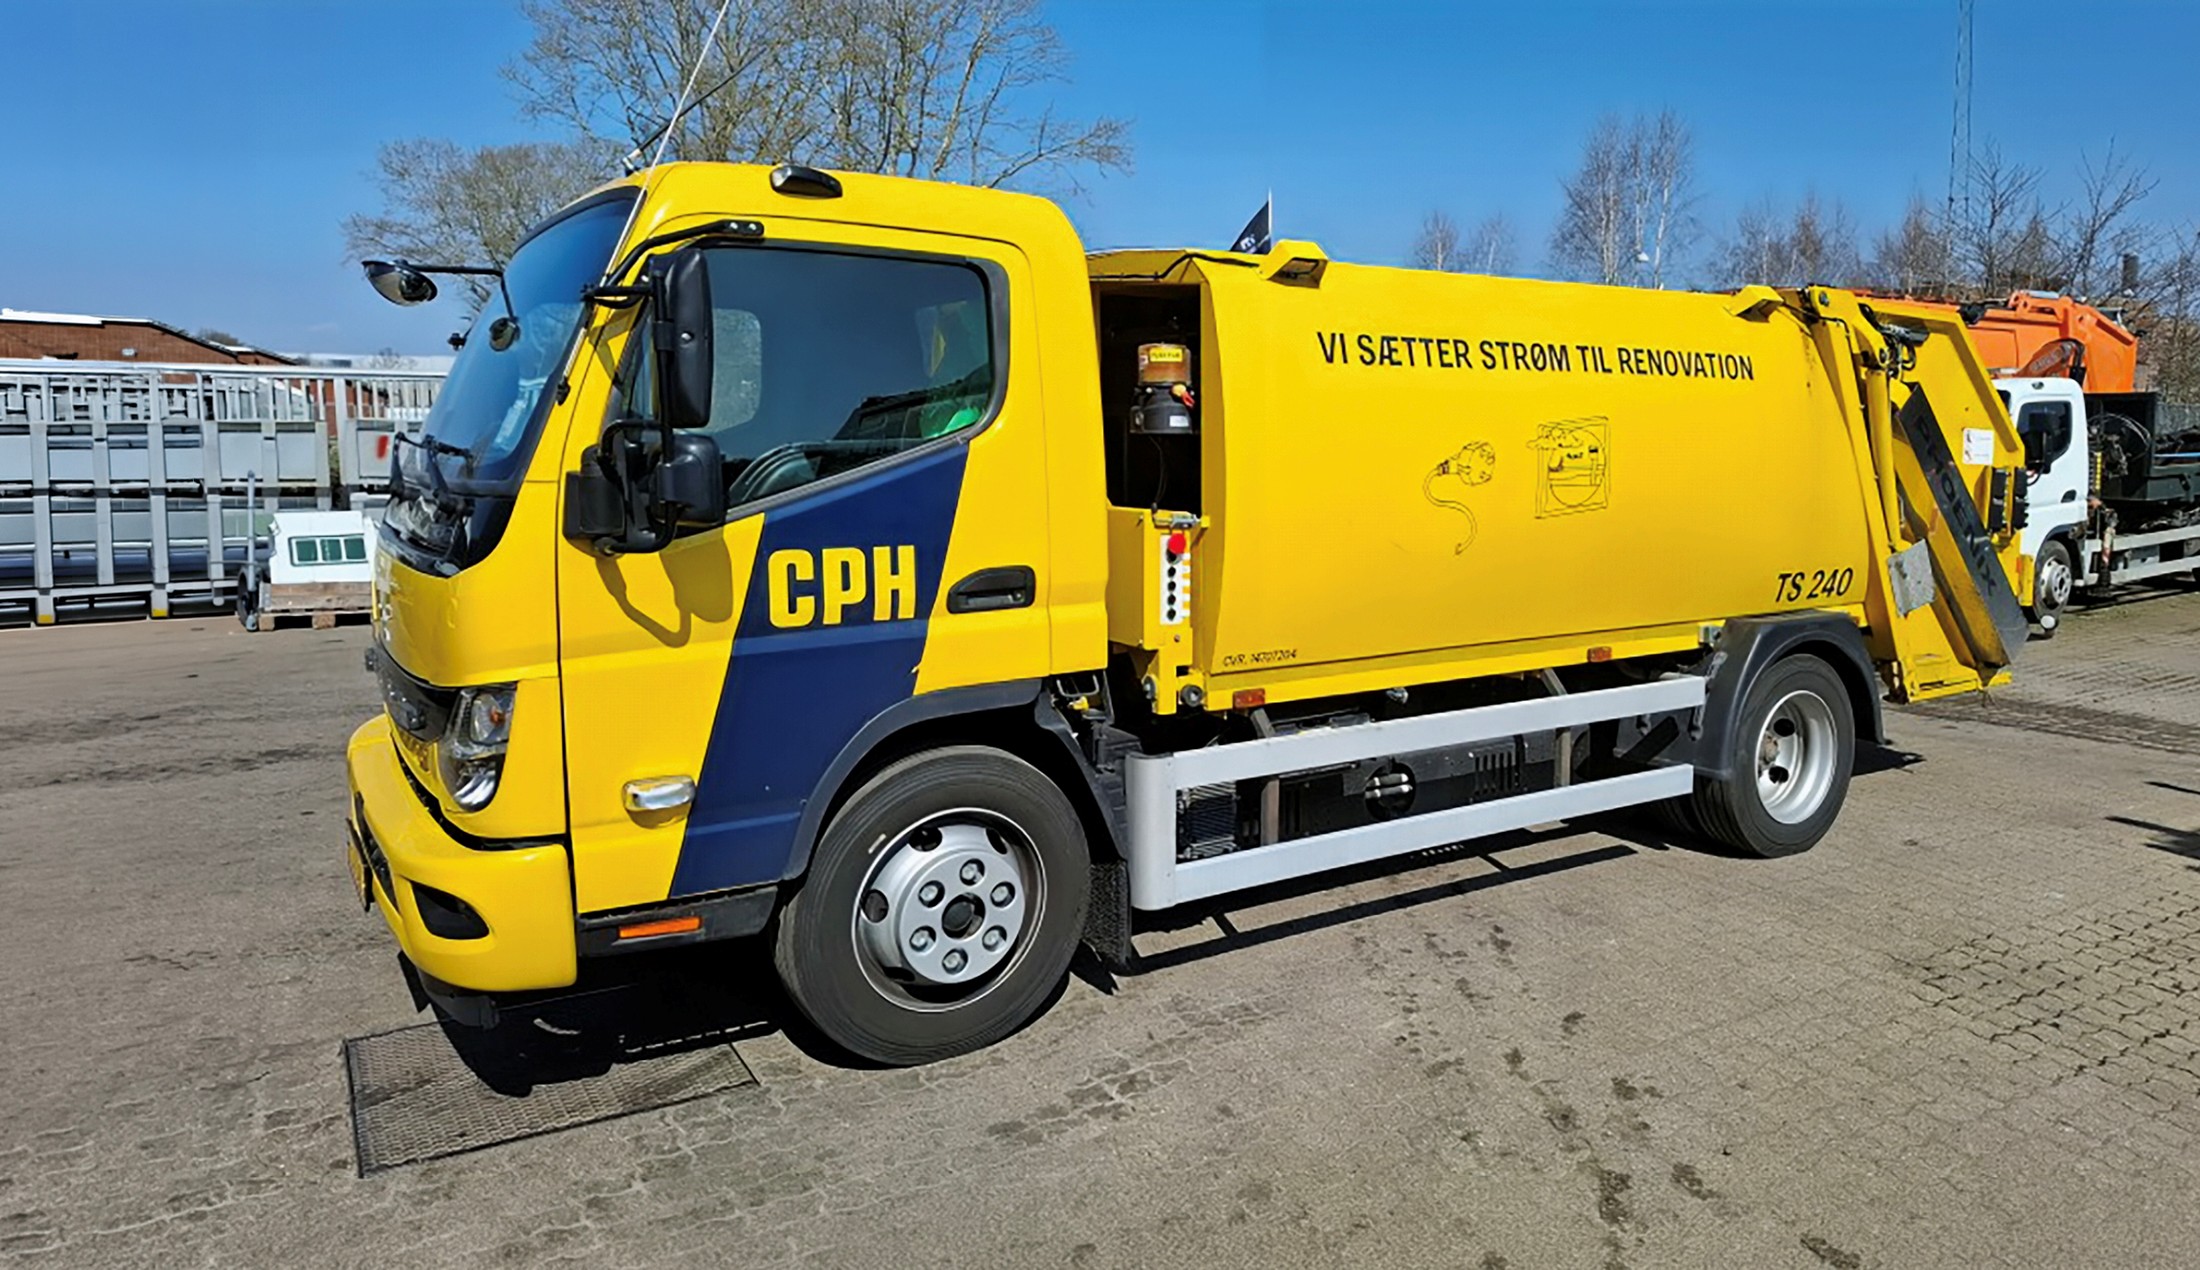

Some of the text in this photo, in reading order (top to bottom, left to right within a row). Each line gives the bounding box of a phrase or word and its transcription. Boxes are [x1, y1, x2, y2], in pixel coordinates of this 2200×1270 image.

[1316, 331, 1754, 381] VI SÆTTER STRØM TIL RENOVATION
[1916, 413, 1997, 597] PHOENIX
[767, 544, 916, 628] CPH
[1775, 567, 1854, 603] TS 240
